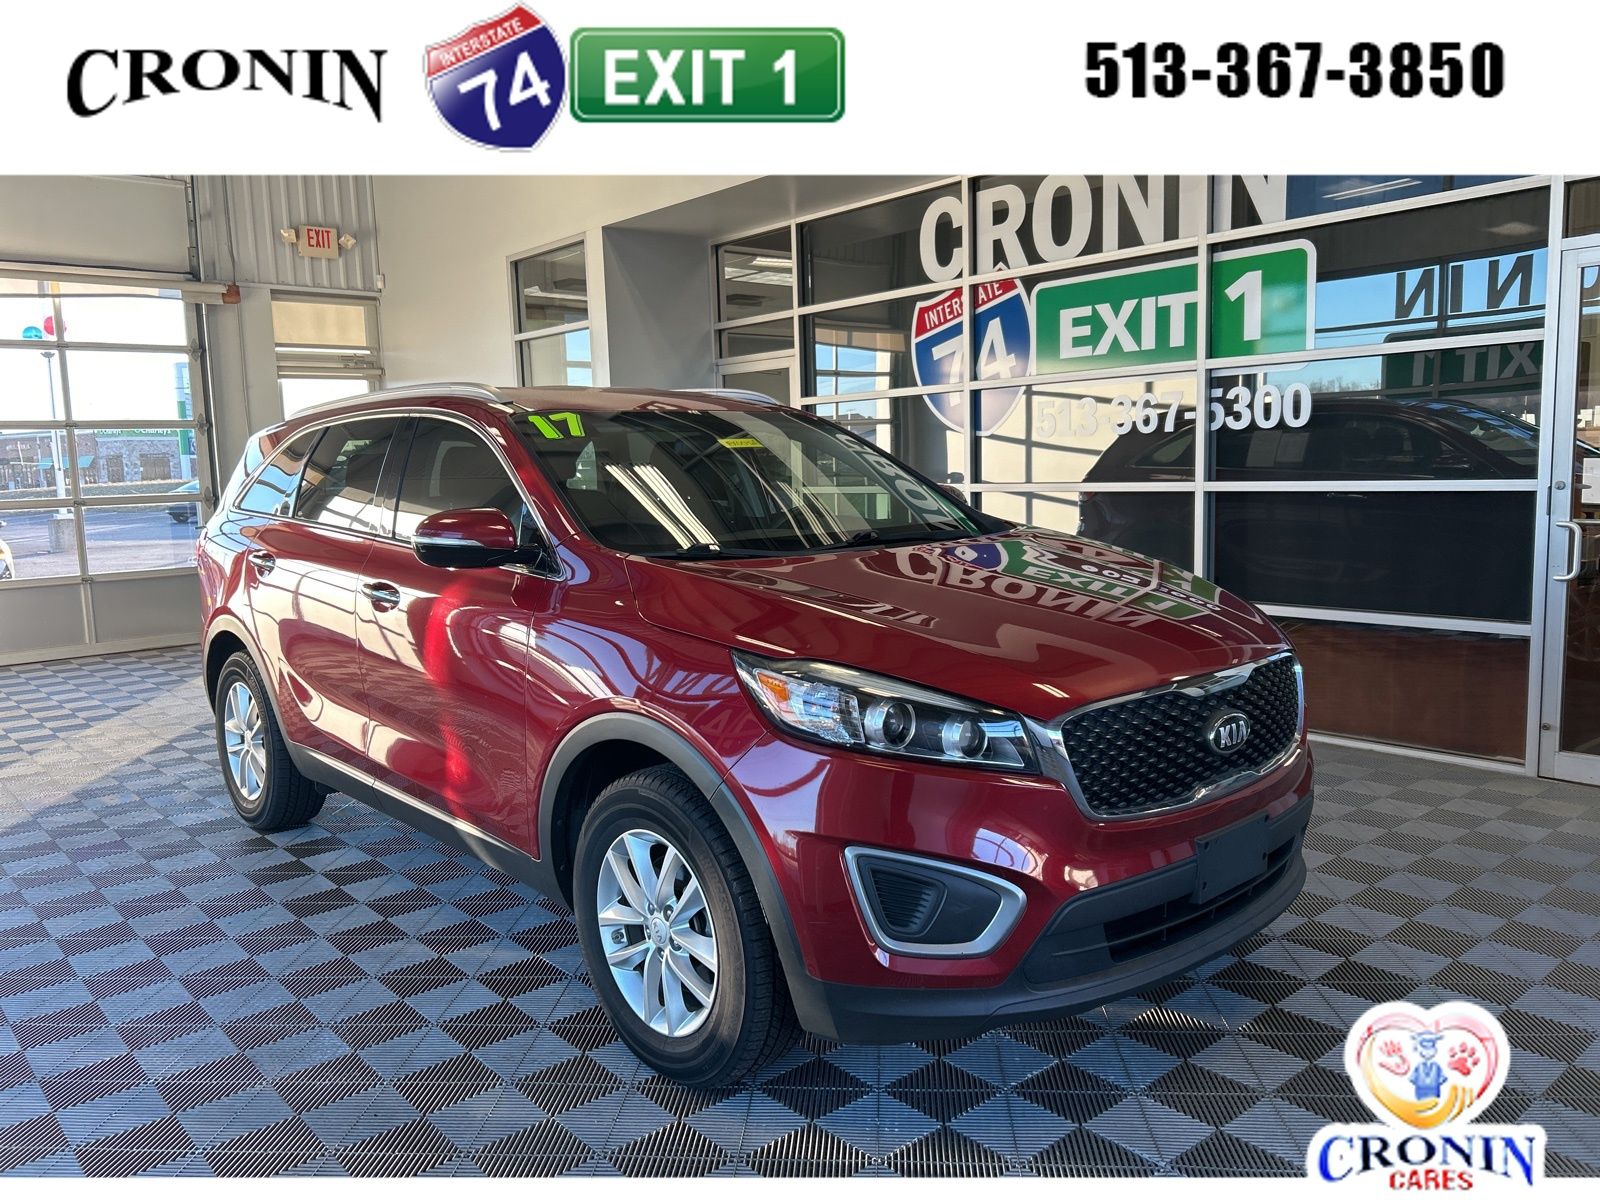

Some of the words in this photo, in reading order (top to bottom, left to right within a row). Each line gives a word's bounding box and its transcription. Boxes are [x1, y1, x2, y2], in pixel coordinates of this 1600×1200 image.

[306, 228, 332, 249] EXIT
[919, 175, 1287, 284] CRONIN
[924, 282, 1003, 330] INTERATE
[1059, 290, 1199, 360] EXIT
[1224, 269, 1262, 342] 1
[931, 316, 1017, 407] 74
[527, 411, 586, 439] 17
[1036, 382, 1312, 439] 513-367-5300
[1218, 720, 1247, 748] KIA
